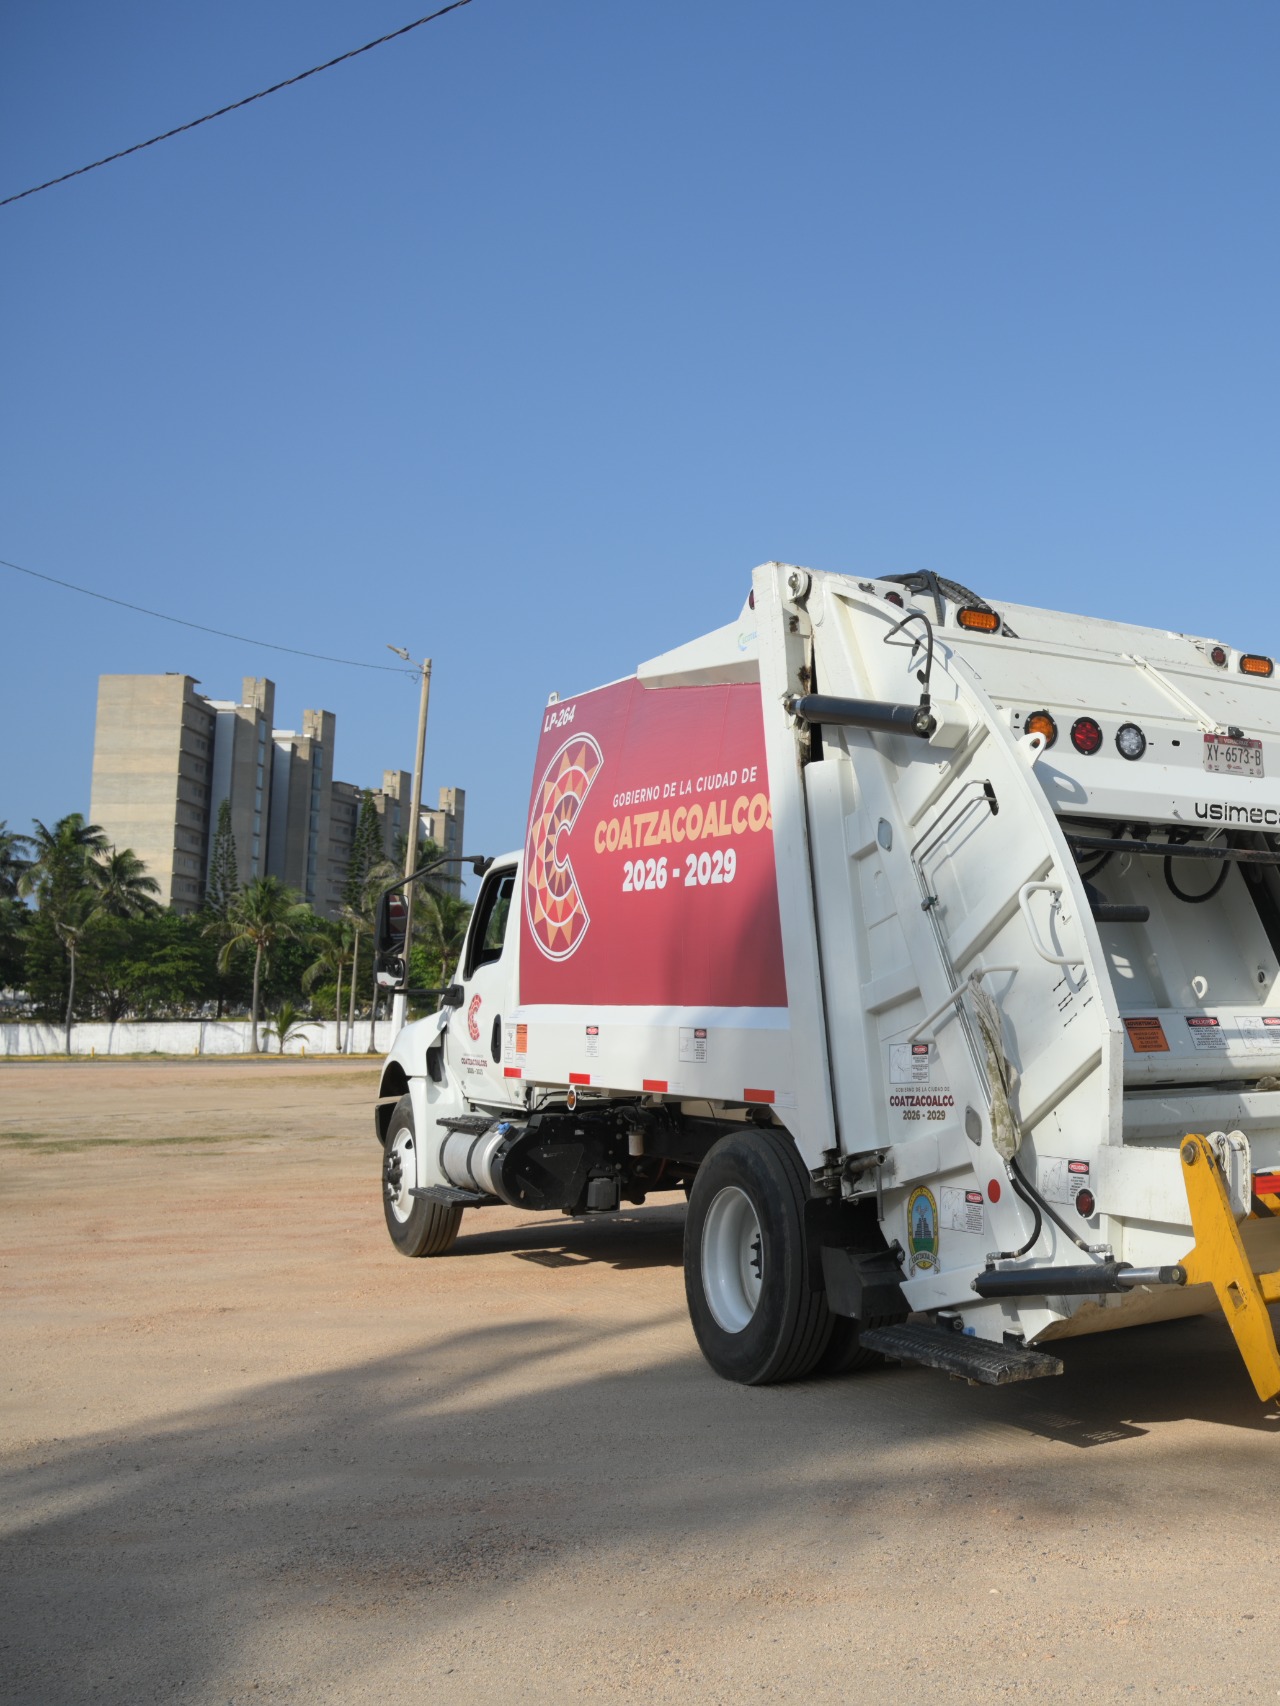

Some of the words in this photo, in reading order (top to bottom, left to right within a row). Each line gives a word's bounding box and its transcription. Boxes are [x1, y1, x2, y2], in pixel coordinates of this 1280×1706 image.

[543, 704, 577, 733] LP-264
[1207, 744, 1261, 766] XY-6573-B
[613, 785, 660, 808] GOBIERNO
[663, 782, 677, 798] DE
[679, 779, 692, 795] LA
[696, 770, 738, 793] CIUDAD
[741, 766, 758, 784] DE
[622, 856, 668, 892] 2026
[672, 868, 681, 878] -
[684, 848, 737, 887] 2029
[889, 1095, 955, 1107] COATZACOALCO
[903, 1110, 921, 1121] 2026
[927, 1110, 946, 1121] 2029
